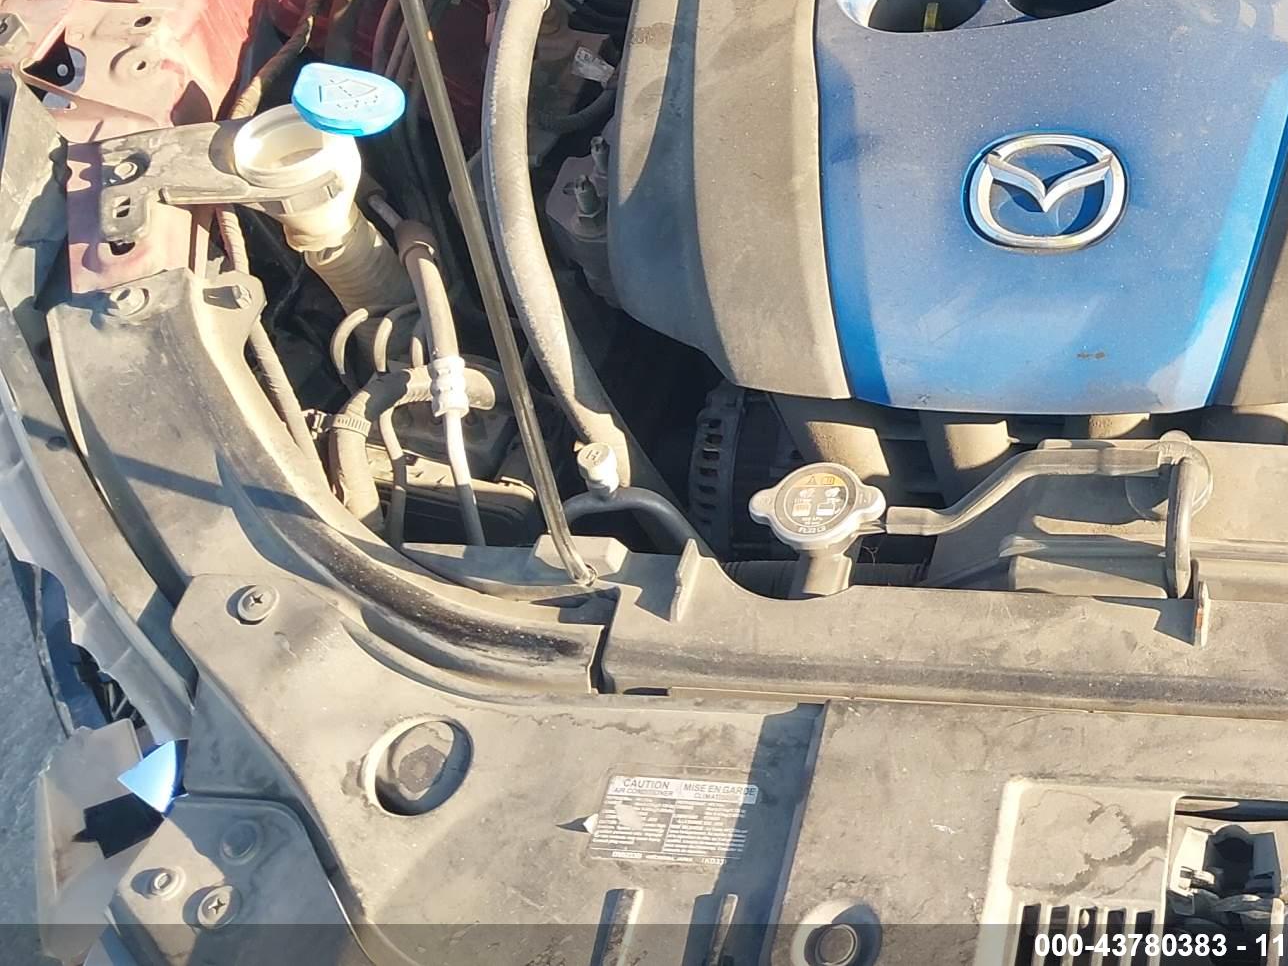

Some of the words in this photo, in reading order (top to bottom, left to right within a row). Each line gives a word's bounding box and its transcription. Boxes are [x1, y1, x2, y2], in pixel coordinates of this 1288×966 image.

[623, 778, 670, 790] CAUTION
[683, 783, 708, 793] MISE
[708, 786, 722, 794] EN
[722, 786, 755, 796] GARDE
